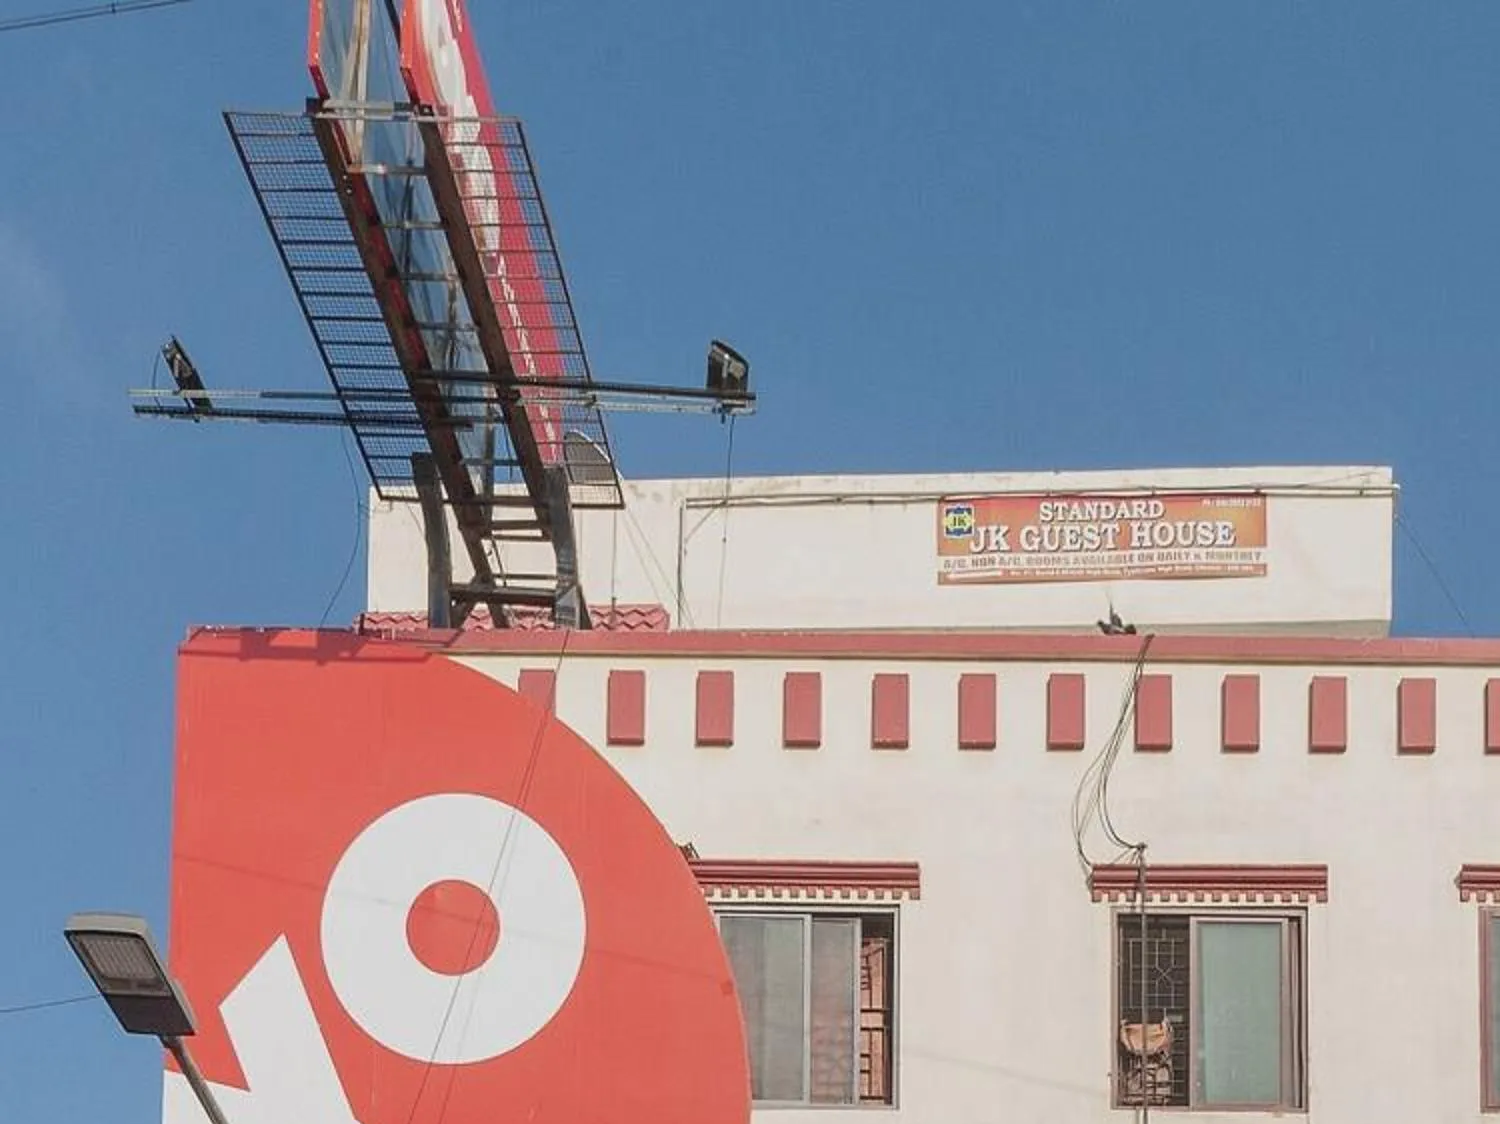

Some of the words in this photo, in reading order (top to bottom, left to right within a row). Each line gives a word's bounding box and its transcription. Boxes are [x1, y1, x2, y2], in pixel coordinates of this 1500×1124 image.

[1039, 500, 1166, 522] STANDARD
[969, 525, 1011, 552] JK
[1020, 523, 1120, 551] GUEST
[1130, 519, 1237, 548] HOUSE
